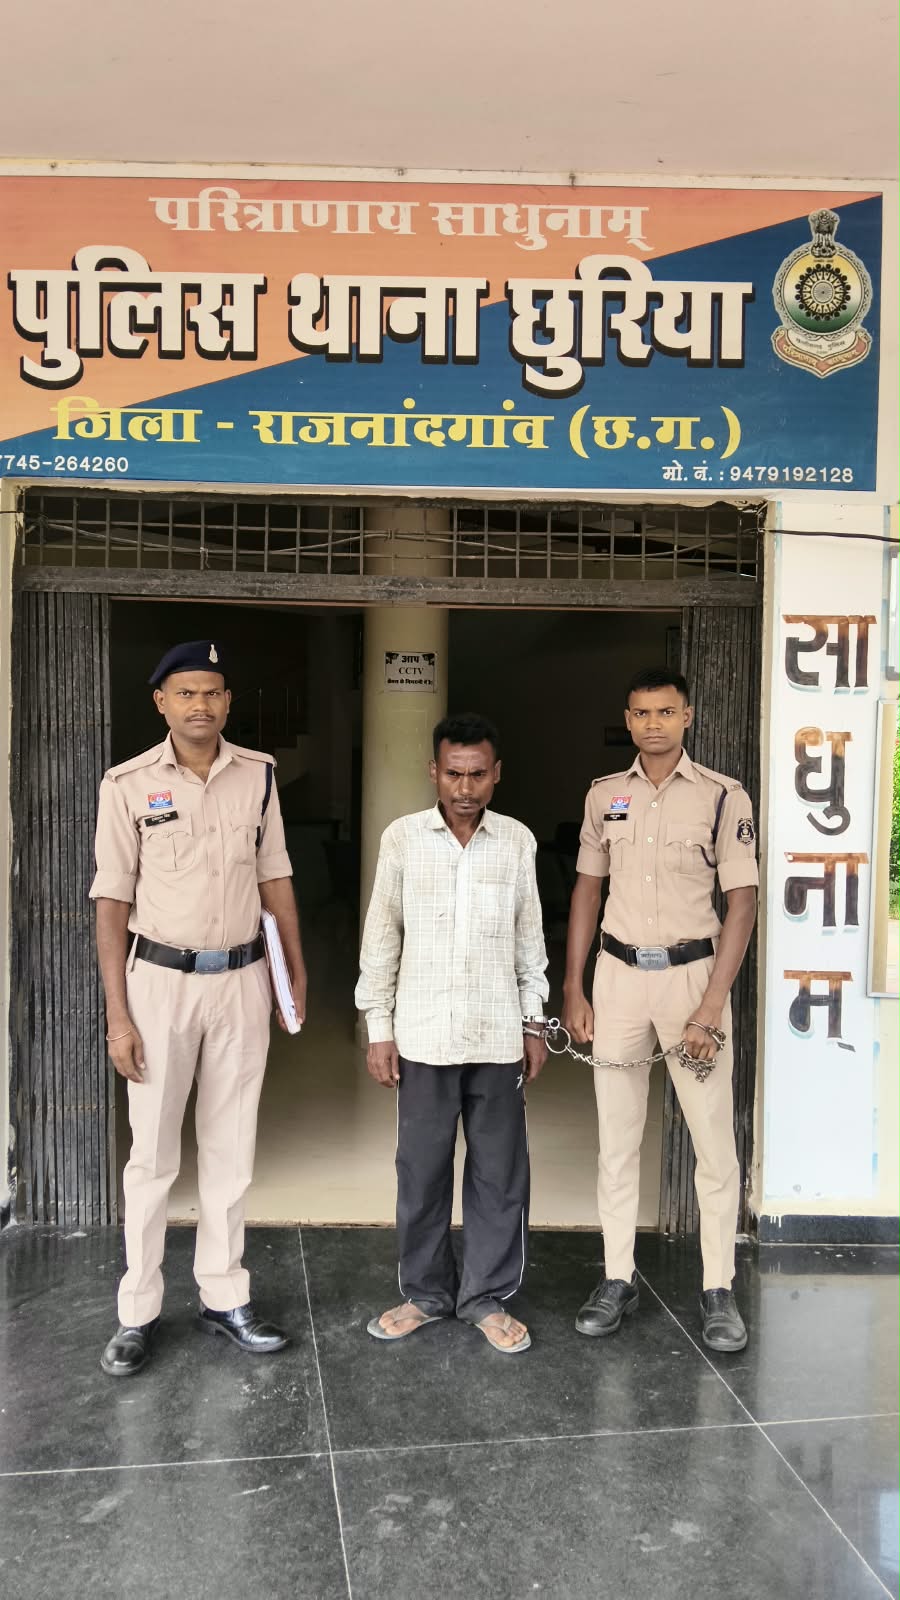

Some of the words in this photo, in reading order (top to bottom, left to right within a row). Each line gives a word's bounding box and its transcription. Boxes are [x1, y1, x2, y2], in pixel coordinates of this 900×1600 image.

[148, 186, 420, 235] परित्राणाय
[429, 201, 655, 251] साधुनाम्
[8, 245, 267, 390] पुलिस
[288, 272, 490, 364] थाना
[505, 254, 754, 399] छुरिया
[50, 396, 203, 442] जिला
[248, 397, 555, 449] राजनांदगांव
[569, 404, 742, 459] (छ.ग.)
[0, 454, 130, 473] 745-264260
[662, 460, 688, 481] मो.
[729, 465, 854, 483] 9479192128
[398, 666, 425, 675] CCTV
